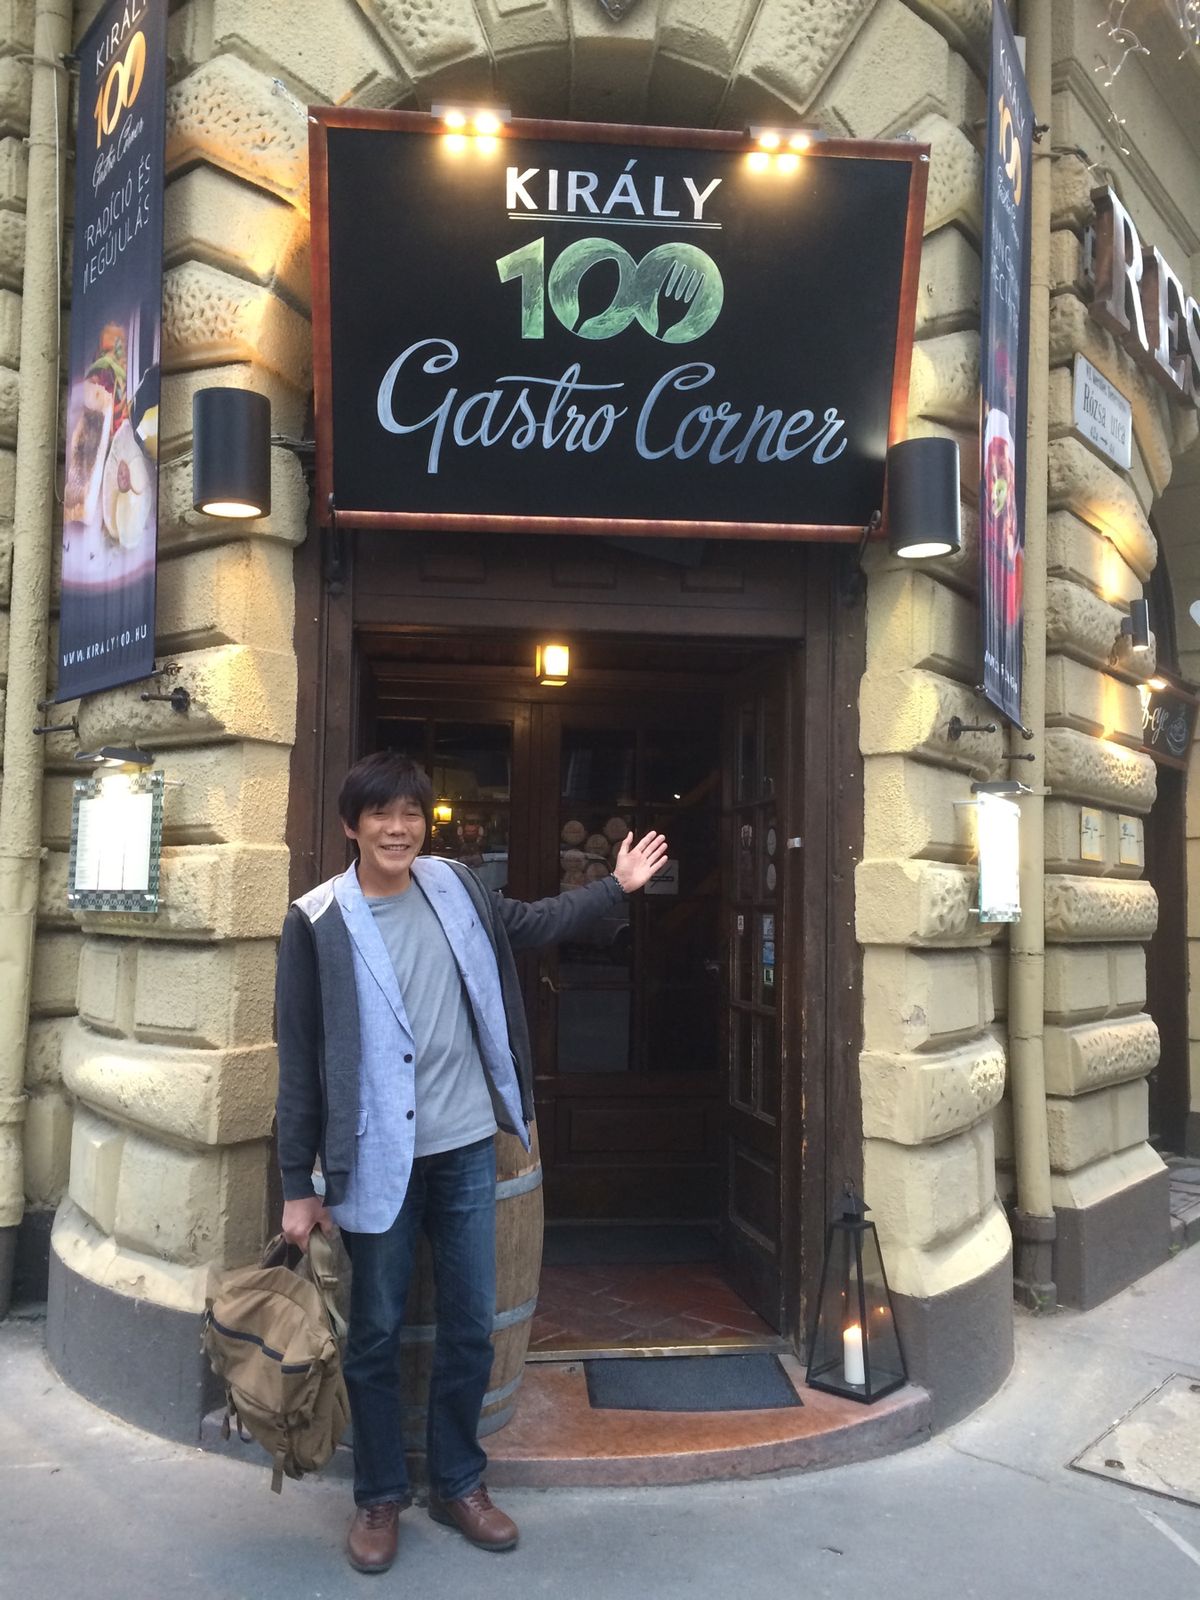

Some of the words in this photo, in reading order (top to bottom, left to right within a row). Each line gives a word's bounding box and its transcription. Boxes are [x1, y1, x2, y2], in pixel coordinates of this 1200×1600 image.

[94, 31, 146, 149] 100
[506, 158, 722, 220] KIRÁLY
[495, 236, 724, 344] 100
[377, 338, 628, 474] Gastro
[635, 362, 848, 465] Corner
